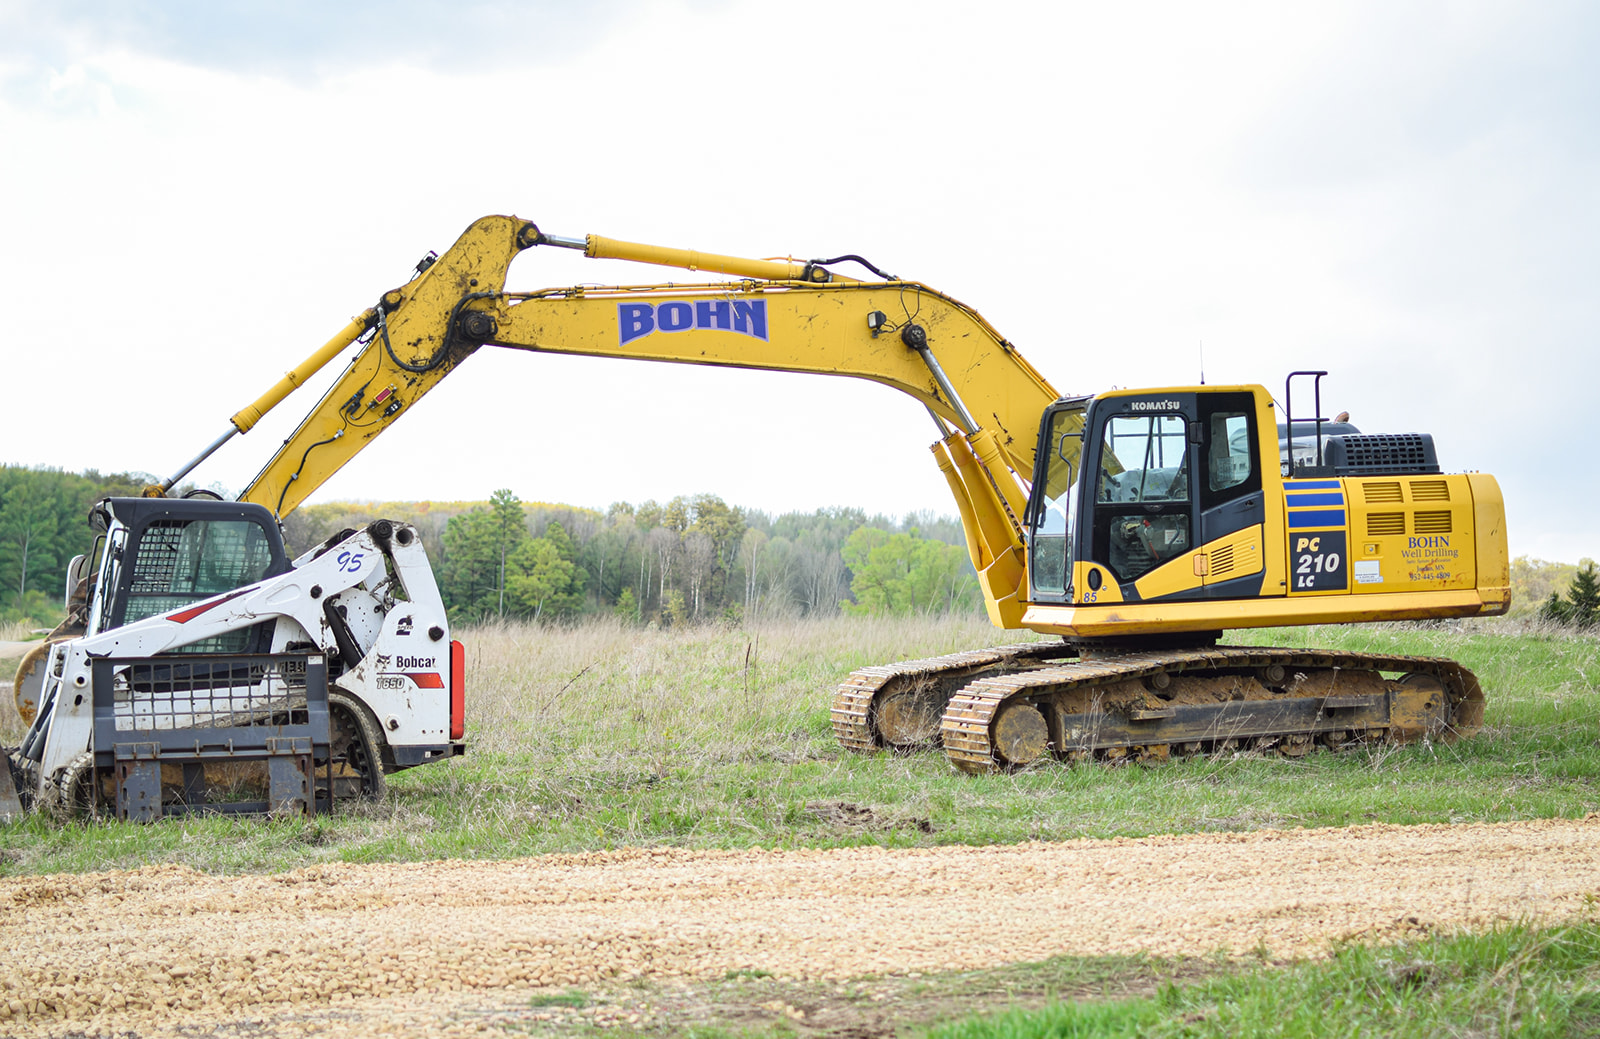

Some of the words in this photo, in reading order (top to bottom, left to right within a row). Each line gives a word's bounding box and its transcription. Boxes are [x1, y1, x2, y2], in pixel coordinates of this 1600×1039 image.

[617, 299, 769, 346] BOHN
[1131, 400, 1180, 411] KOMATSU
[1296, 537, 1320, 552] PC
[1408, 536, 1450, 548] BOHN
[1401, 550, 1422, 558] Well
[1424, 548, 1459, 558] Drilling
[337, 551, 364, 572] 95
[1296, 553, 1340, 573] 210
[1297, 575, 1315, 588] LC
[1083, 592, 1097, 603] 85
[396, 617, 413, 636] 2
[396, 655, 436, 668] Bobcat
[376, 677, 405, 690] T650
